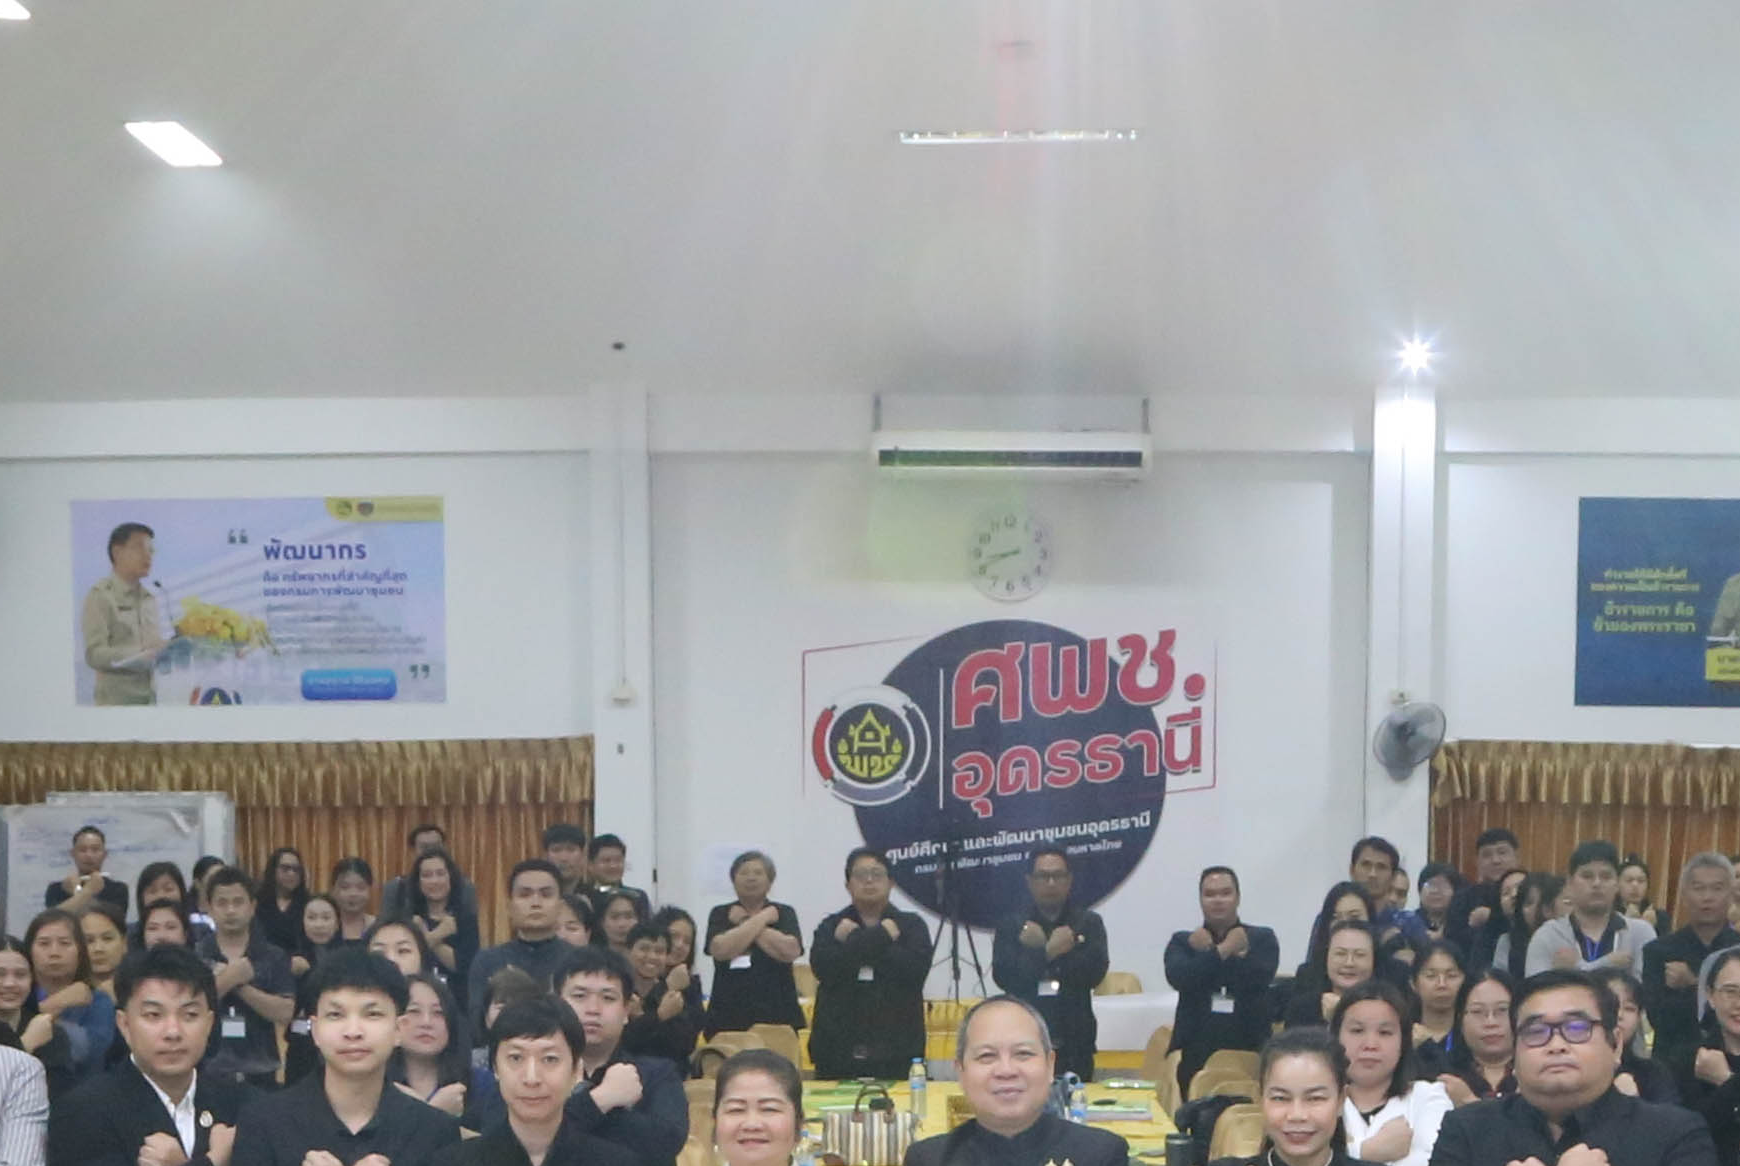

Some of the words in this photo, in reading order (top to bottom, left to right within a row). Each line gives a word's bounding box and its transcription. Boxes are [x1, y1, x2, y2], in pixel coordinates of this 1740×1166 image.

[262, 537, 367, 561] พัฒนากร
[951, 628, 1206, 729] ศพช.
[951, 705, 1202, 819] อุดรธานี
